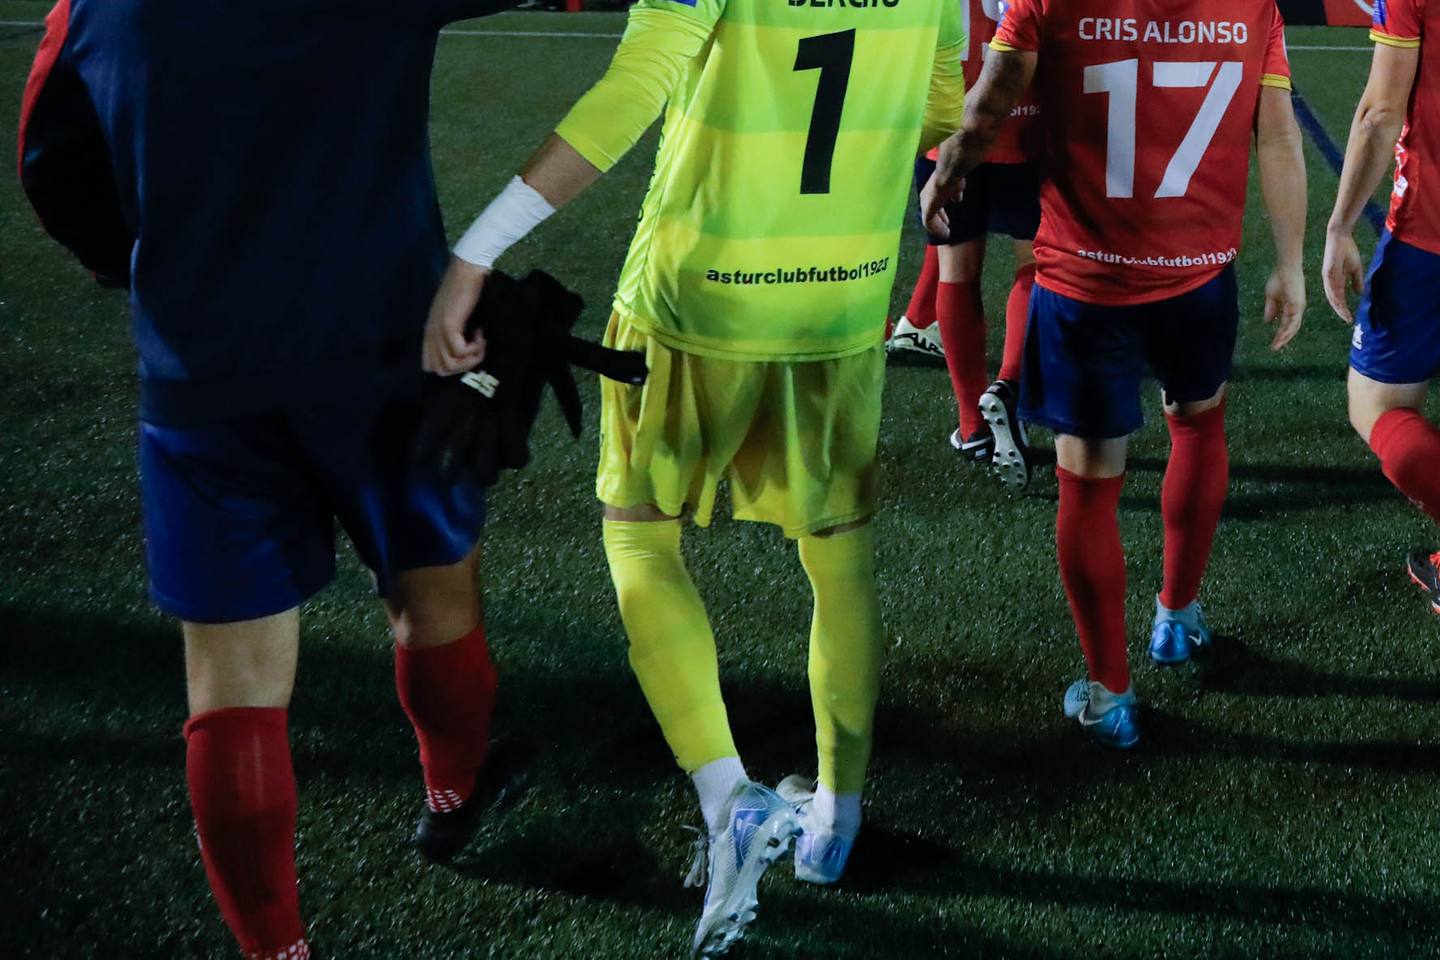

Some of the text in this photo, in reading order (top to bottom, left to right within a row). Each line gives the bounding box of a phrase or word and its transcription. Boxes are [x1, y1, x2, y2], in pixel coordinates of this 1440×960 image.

[1078, 17, 1249, 45] CRIS ALONSO
[793, 28, 856, 195] 1
[1083, 58, 1244, 199] 17
[706, 256, 889, 284] asturclubfutbol1923
